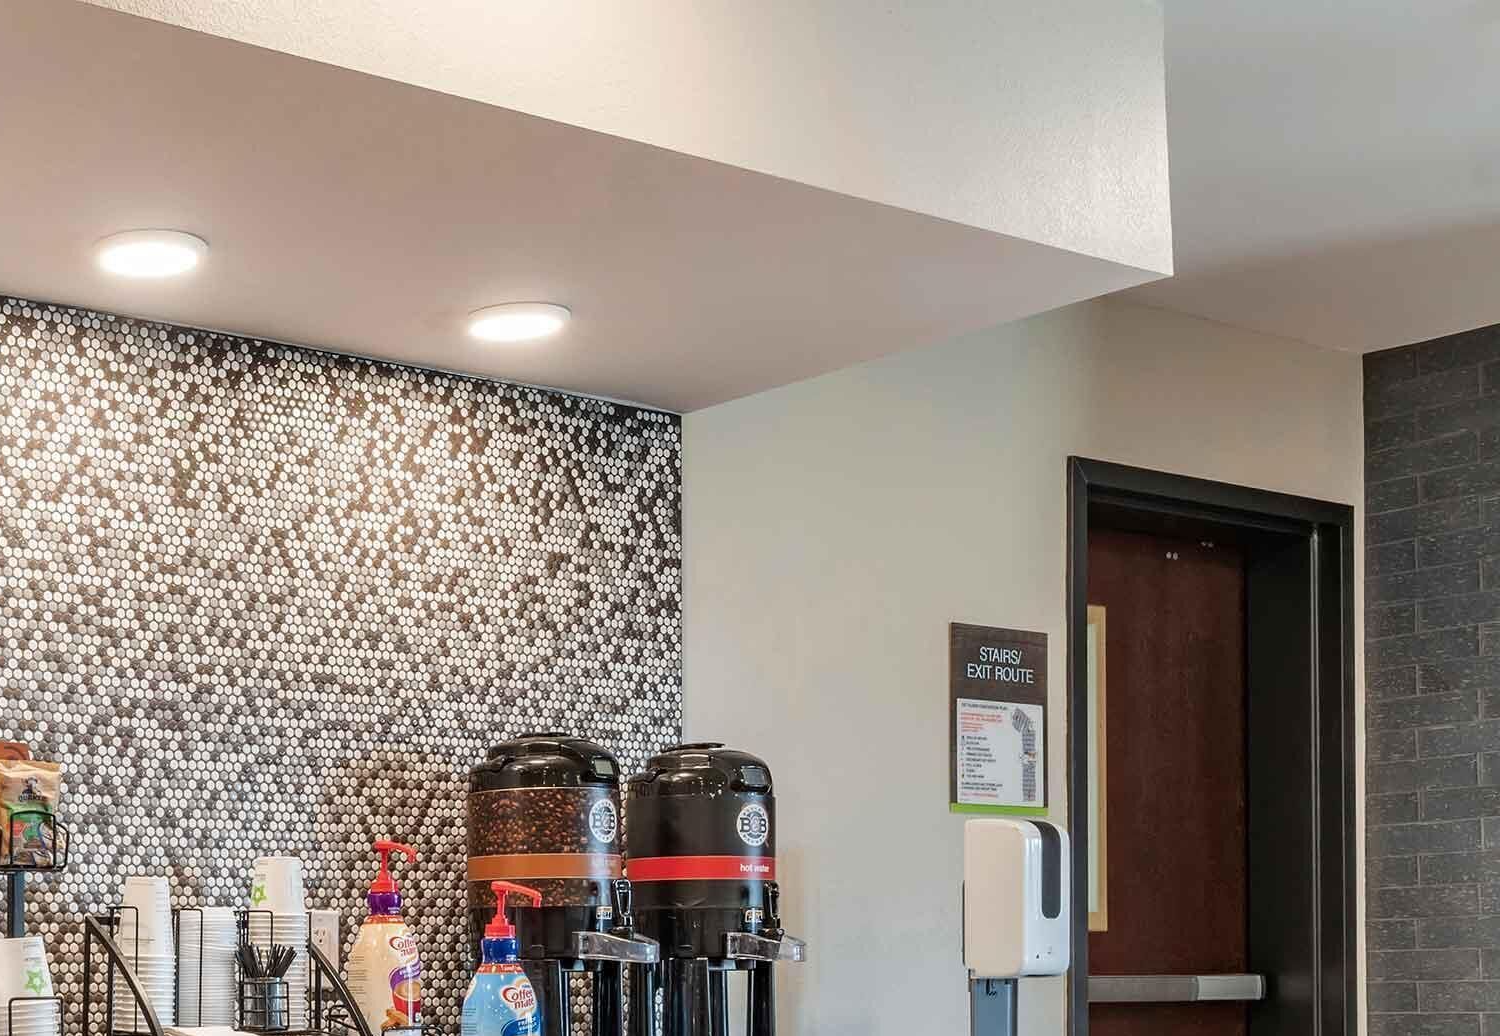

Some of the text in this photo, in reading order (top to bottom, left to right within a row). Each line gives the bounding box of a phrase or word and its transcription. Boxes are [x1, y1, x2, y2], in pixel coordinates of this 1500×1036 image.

[979, 646, 1022, 665] STAIRS/
[967, 663, 1034, 684] EXIT ROUTE
[739, 863, 752, 872] hot
